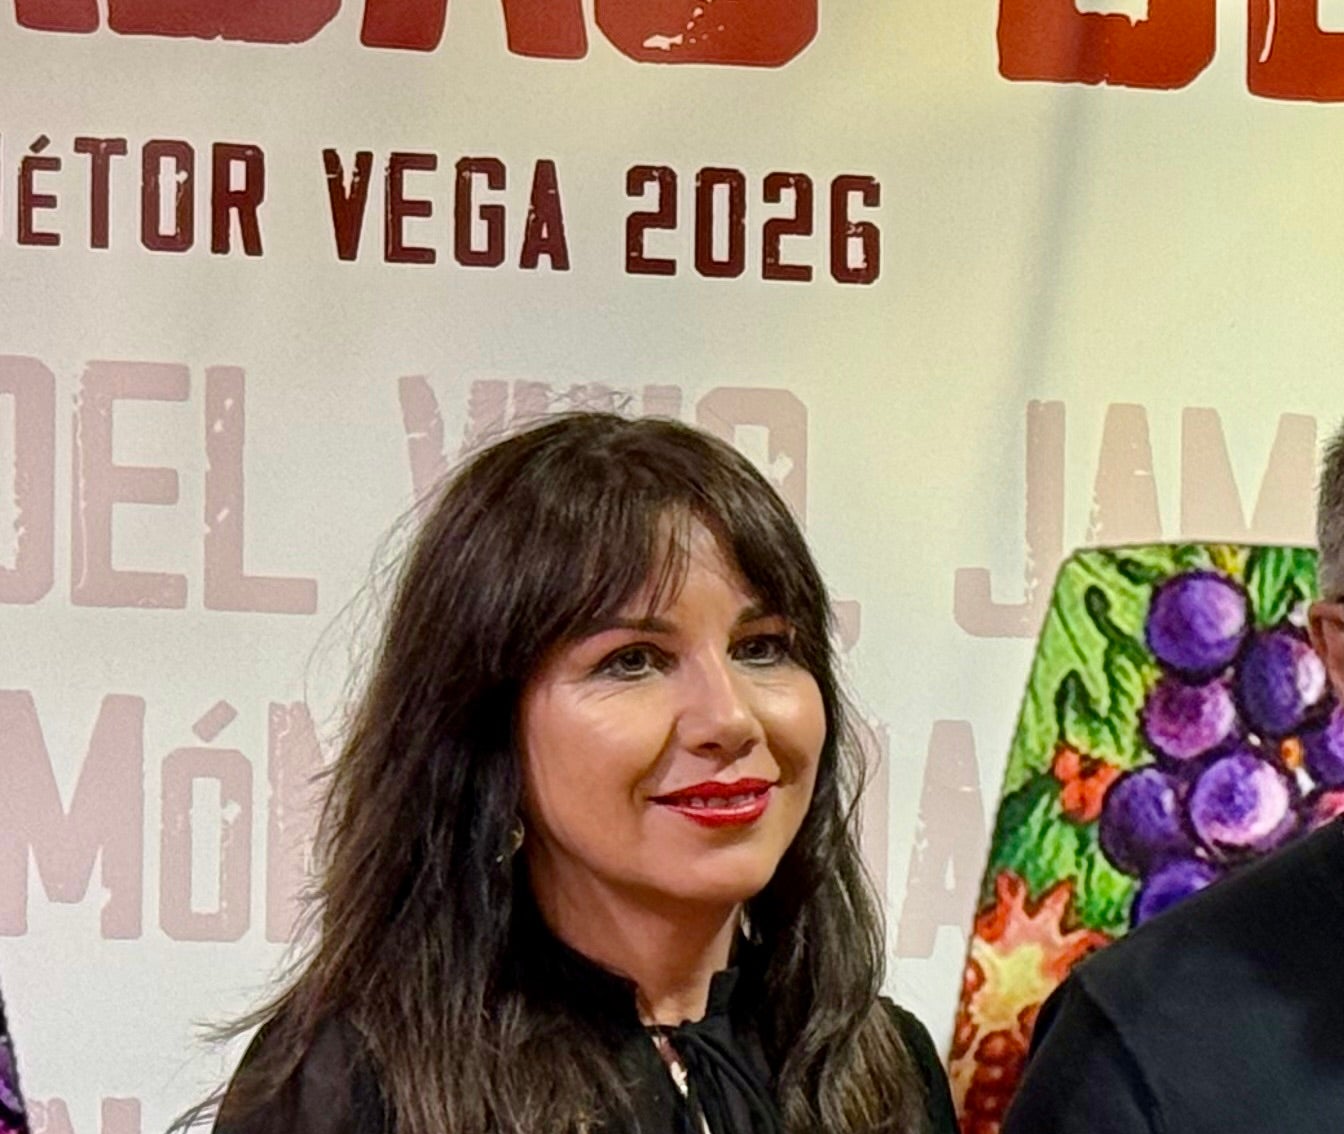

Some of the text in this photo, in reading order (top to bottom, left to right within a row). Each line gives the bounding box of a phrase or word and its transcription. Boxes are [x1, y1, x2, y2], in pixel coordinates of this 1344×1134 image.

[322, 148, 571, 271] VEGA
[625, 165, 882, 286] 2026
[953, 399, 1318, 638] JAM
